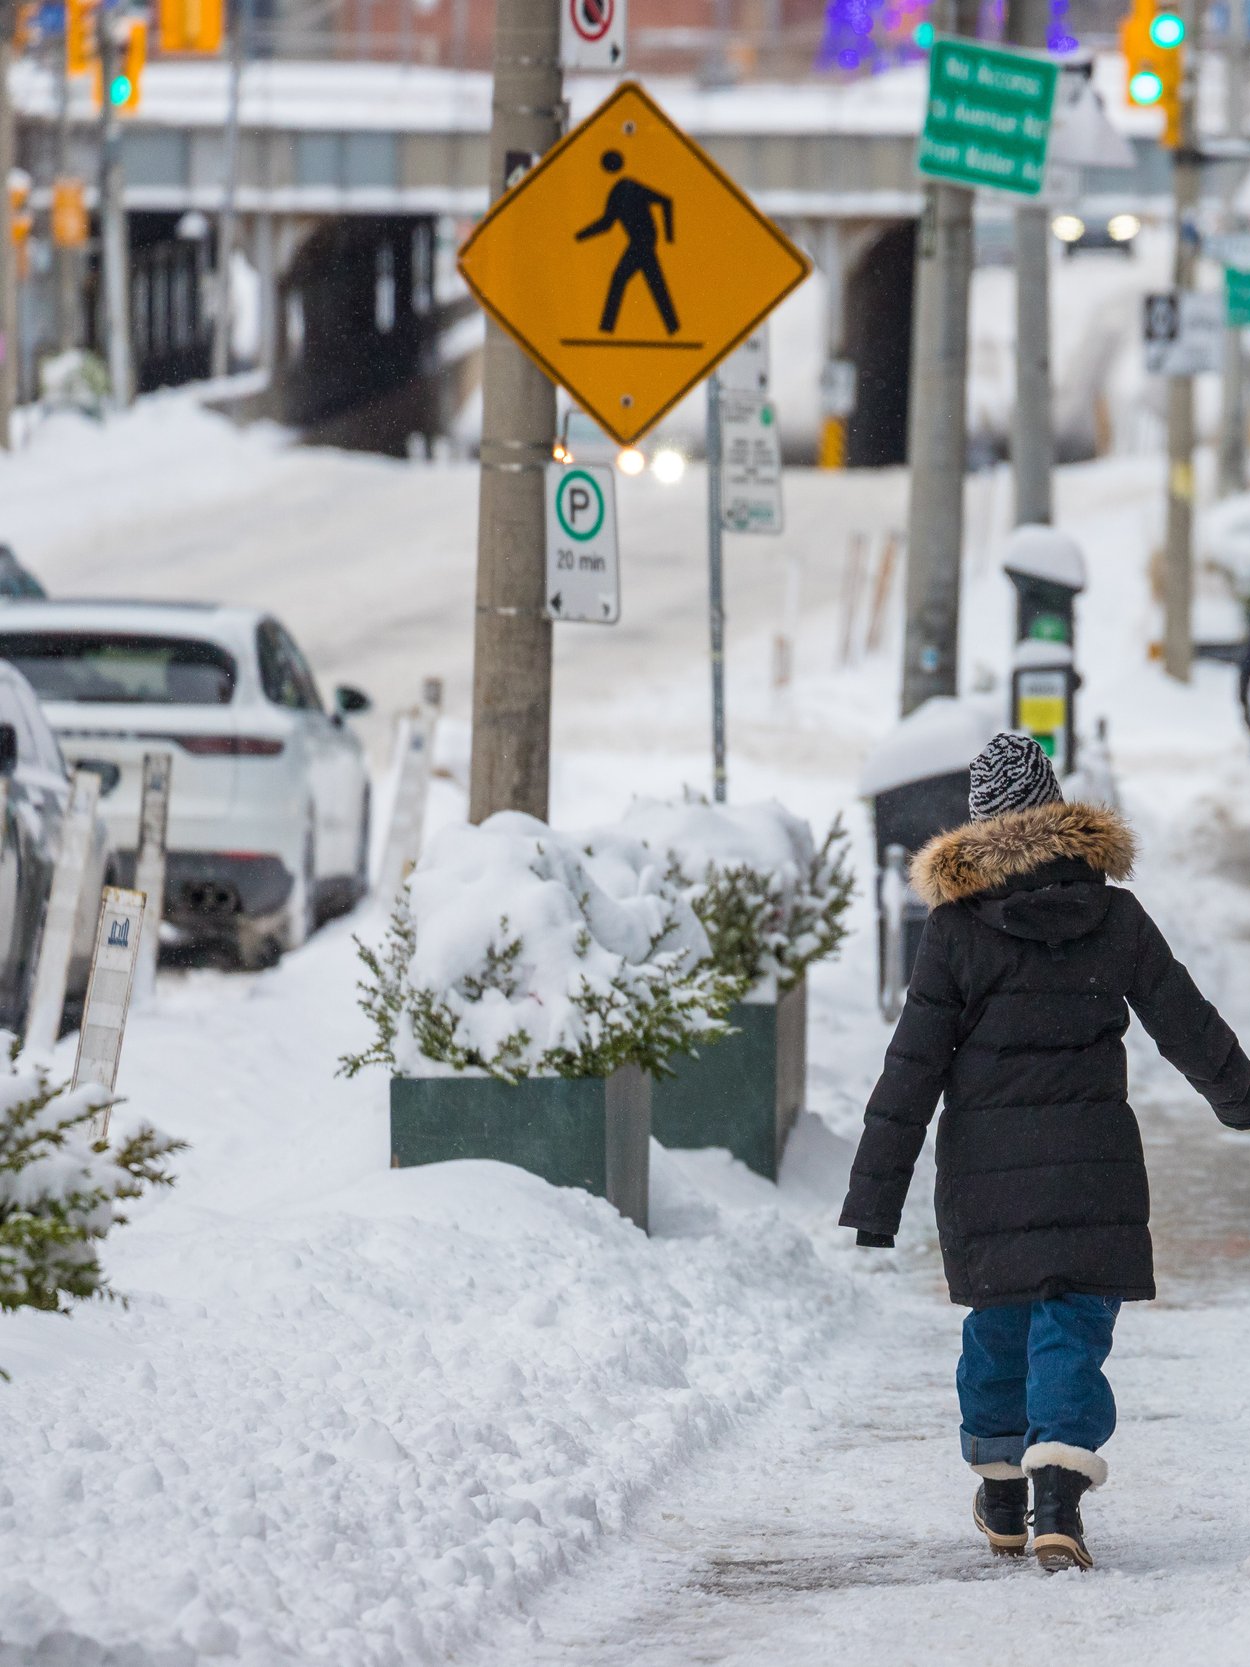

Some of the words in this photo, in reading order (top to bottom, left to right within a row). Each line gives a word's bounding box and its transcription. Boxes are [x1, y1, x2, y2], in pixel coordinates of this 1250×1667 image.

[569, 488, 590, 523] P
[557, 549, 574, 570] 20
[579, 554, 606, 573] min
